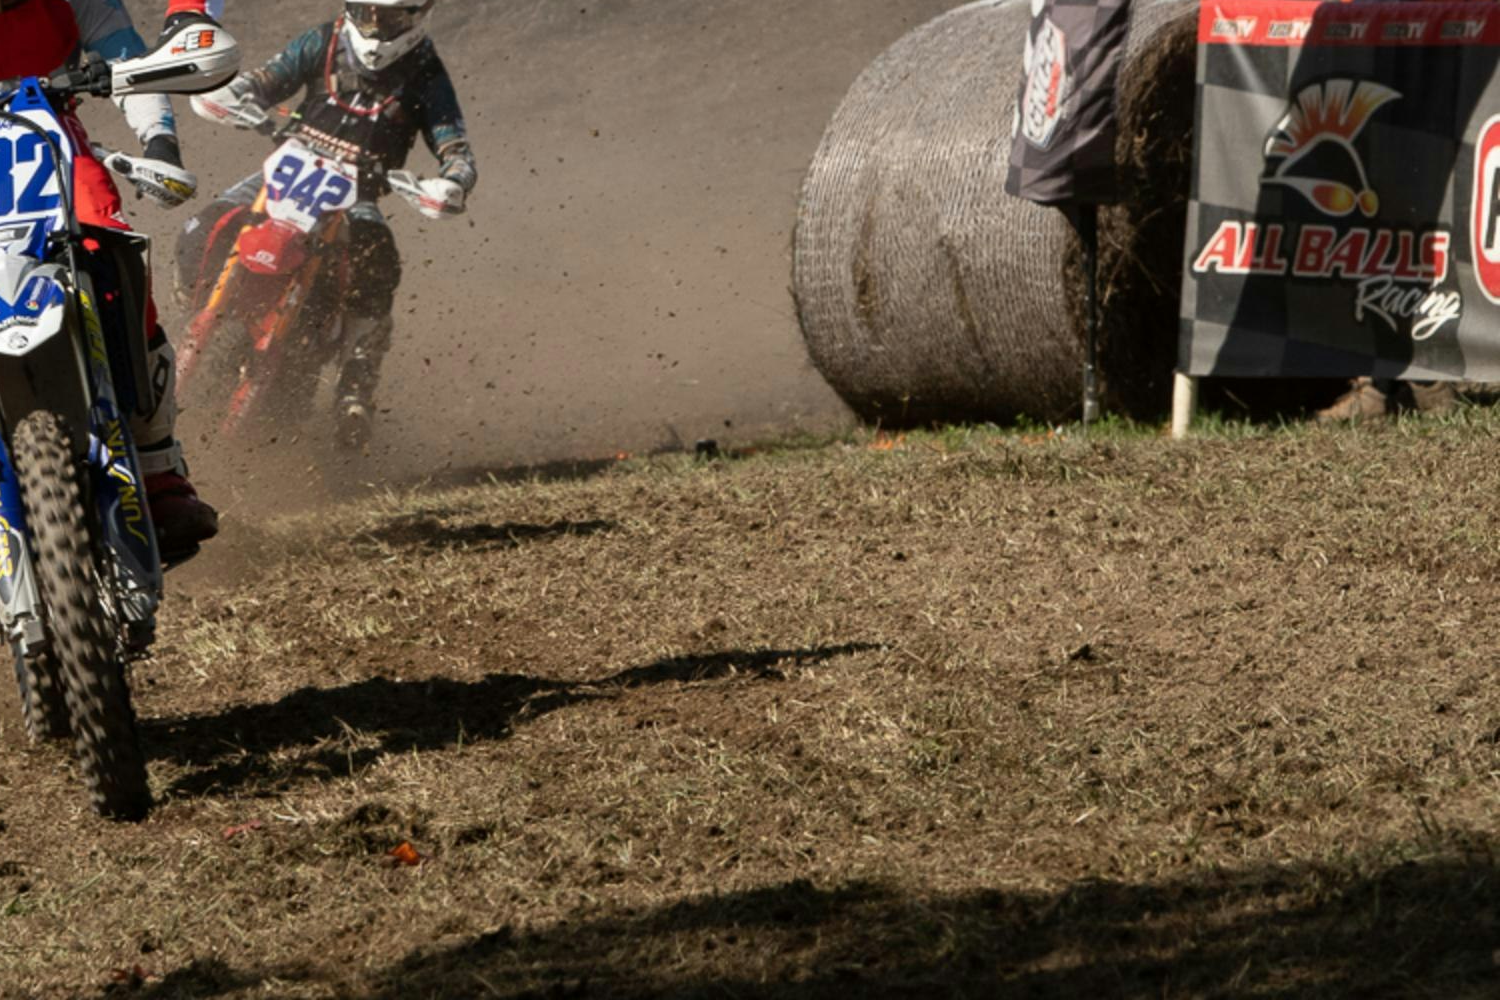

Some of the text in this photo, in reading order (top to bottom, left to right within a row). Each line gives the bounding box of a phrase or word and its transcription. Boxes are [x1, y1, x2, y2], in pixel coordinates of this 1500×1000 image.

[267, 154, 353, 217] 942
[1194, 220, 1450, 284] ALL BALLS
[1356, 273, 1461, 341] Racing
